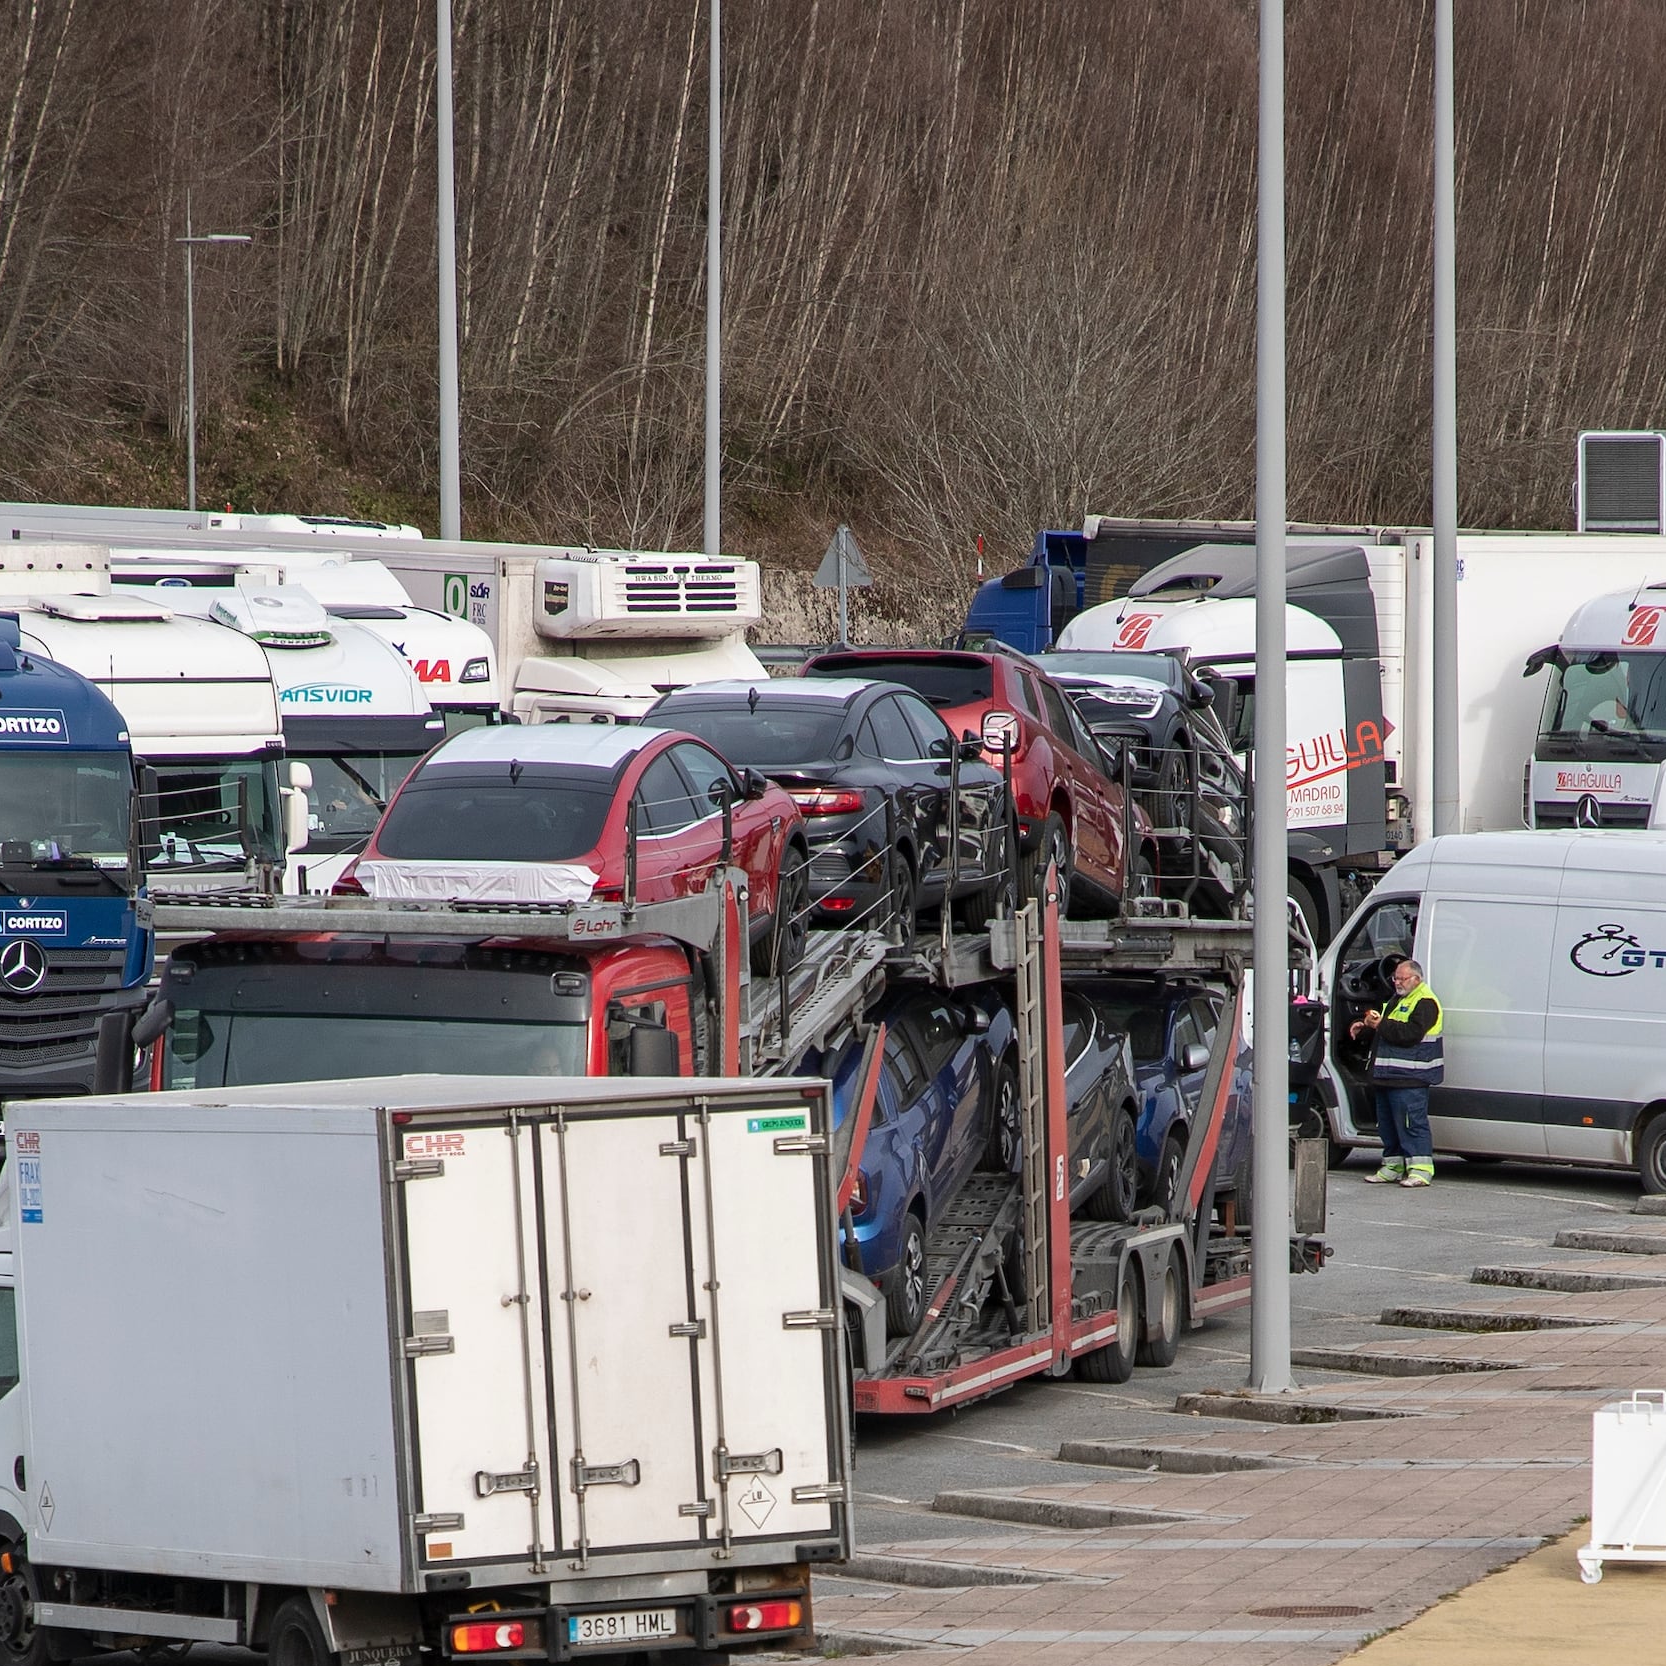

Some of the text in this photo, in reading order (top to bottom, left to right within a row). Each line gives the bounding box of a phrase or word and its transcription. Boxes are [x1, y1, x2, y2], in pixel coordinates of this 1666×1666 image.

[635, 574, 674, 582] HWASUNG
[473, 602, 487, 617] FRC
[1566, 773, 1622, 789] ALIAGUILLA
[1290, 785, 1341, 803] MADRID
[1294, 807, 1304, 817] 91
[1305, 806, 1321, 816] 507
[8, 916, 62, 930] CORTIZO
[586, 919, 618, 934] Lohr
[16, 1132, 40, 1149] CHR
[405, 1133, 464, 1153] CHR
[582, 1611, 672, 1638] 3681 HML
[349, 1646, 413, 1663] JUNQUERA
